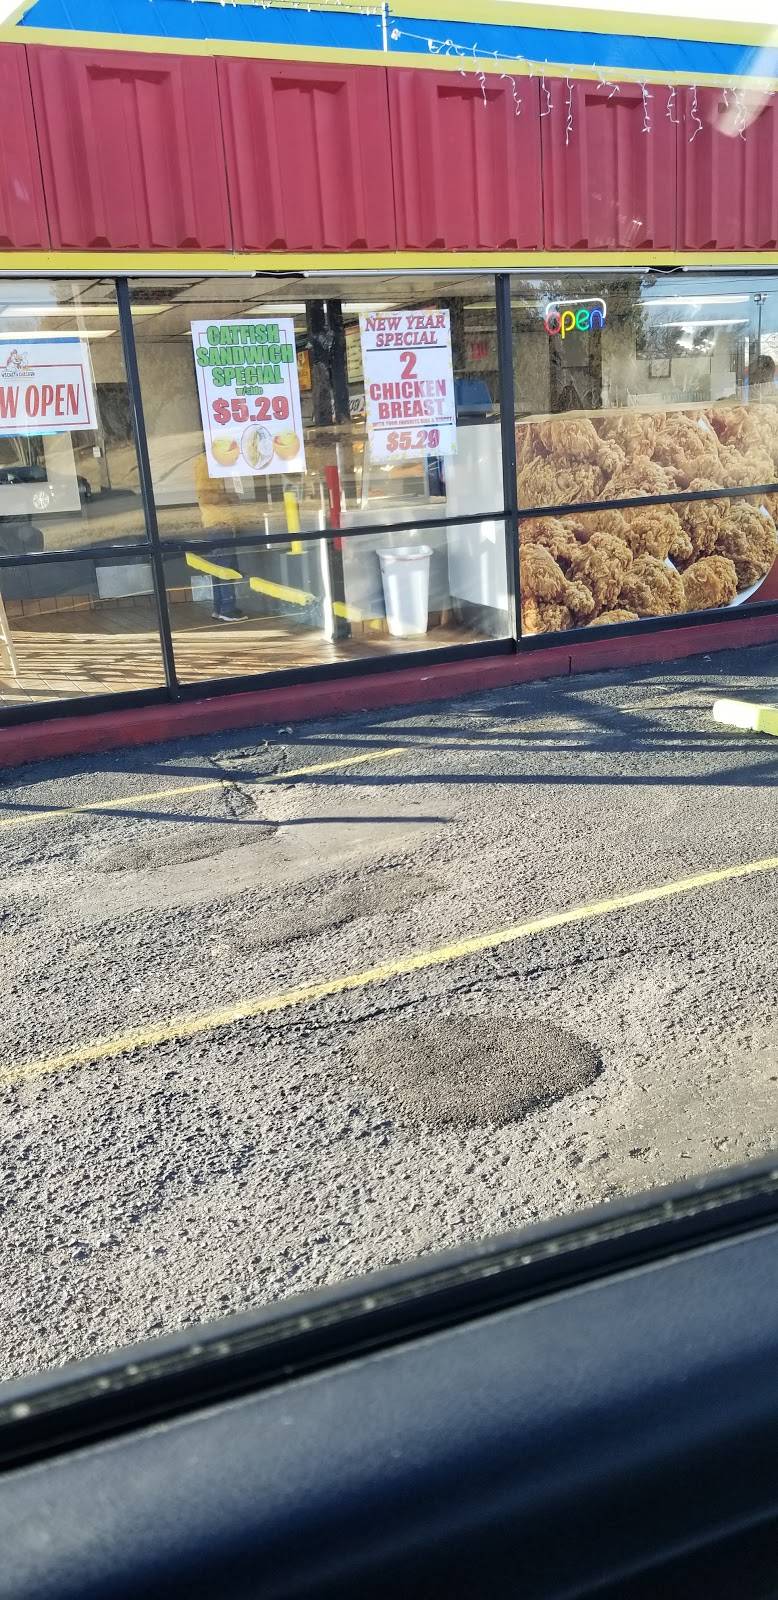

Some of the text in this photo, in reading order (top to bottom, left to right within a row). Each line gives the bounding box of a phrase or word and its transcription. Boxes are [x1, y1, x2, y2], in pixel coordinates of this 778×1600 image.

[365, 313, 446, 332] NEW YEAR
[206, 324, 280, 345] CATFISH
[376, 331, 438, 348] SPECIAL
[196, 344, 294, 367] SANDWICH
[399, 351, 417, 380] 2
[212, 365, 284, 387] SPECIAL
[25, 384, 79, 417] OPEN
[369, 379, 447, 401] CHICKEN
[212, 395, 290, 425] $5.29
[378, 398, 445, 420] BREAST
[386, 428, 441, 452] $5.29
